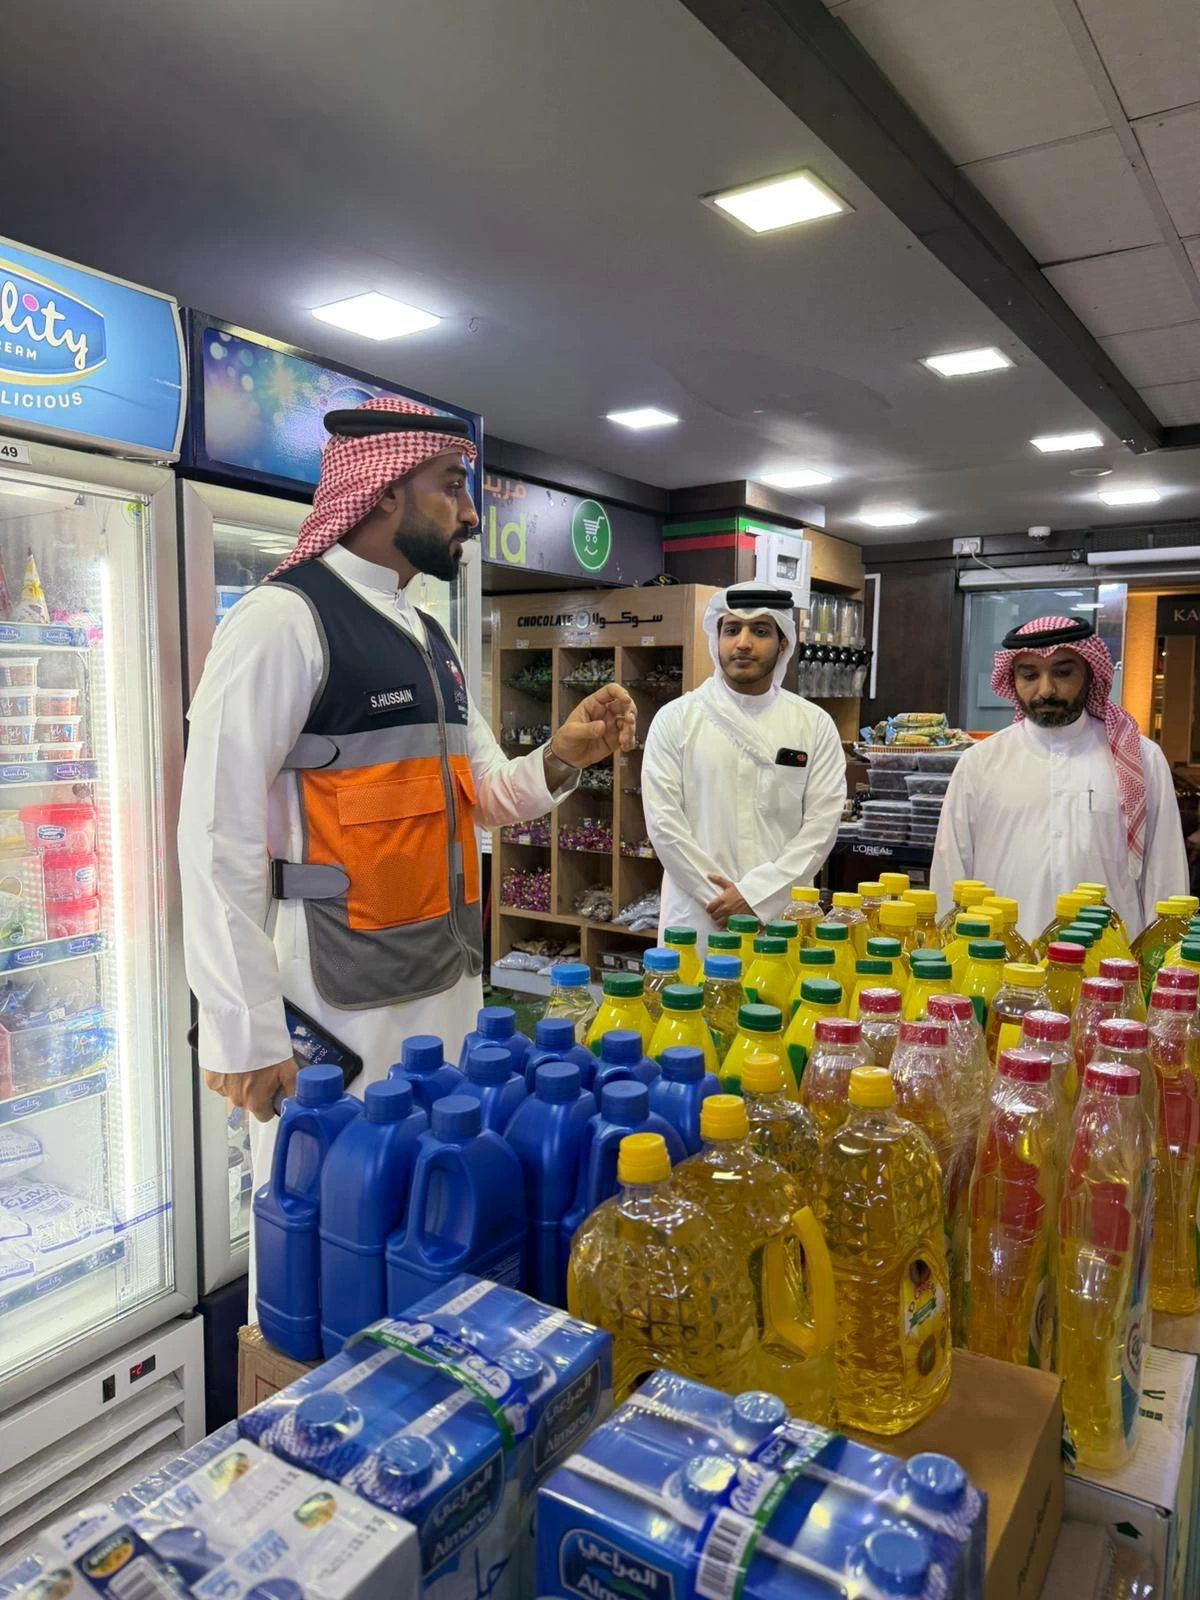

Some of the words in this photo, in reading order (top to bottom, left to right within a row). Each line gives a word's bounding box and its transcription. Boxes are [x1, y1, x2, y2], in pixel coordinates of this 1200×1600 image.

[0, 340, 37, 361] EAM
[0, 390, 83, 408] LICIOUS
[0, 445, 18, 458] 49
[370, 688, 414, 708] S.HUSSAIN
[544, 1405, 592, 1457] Almarai
[577, 1573, 630, 1600] Alm
